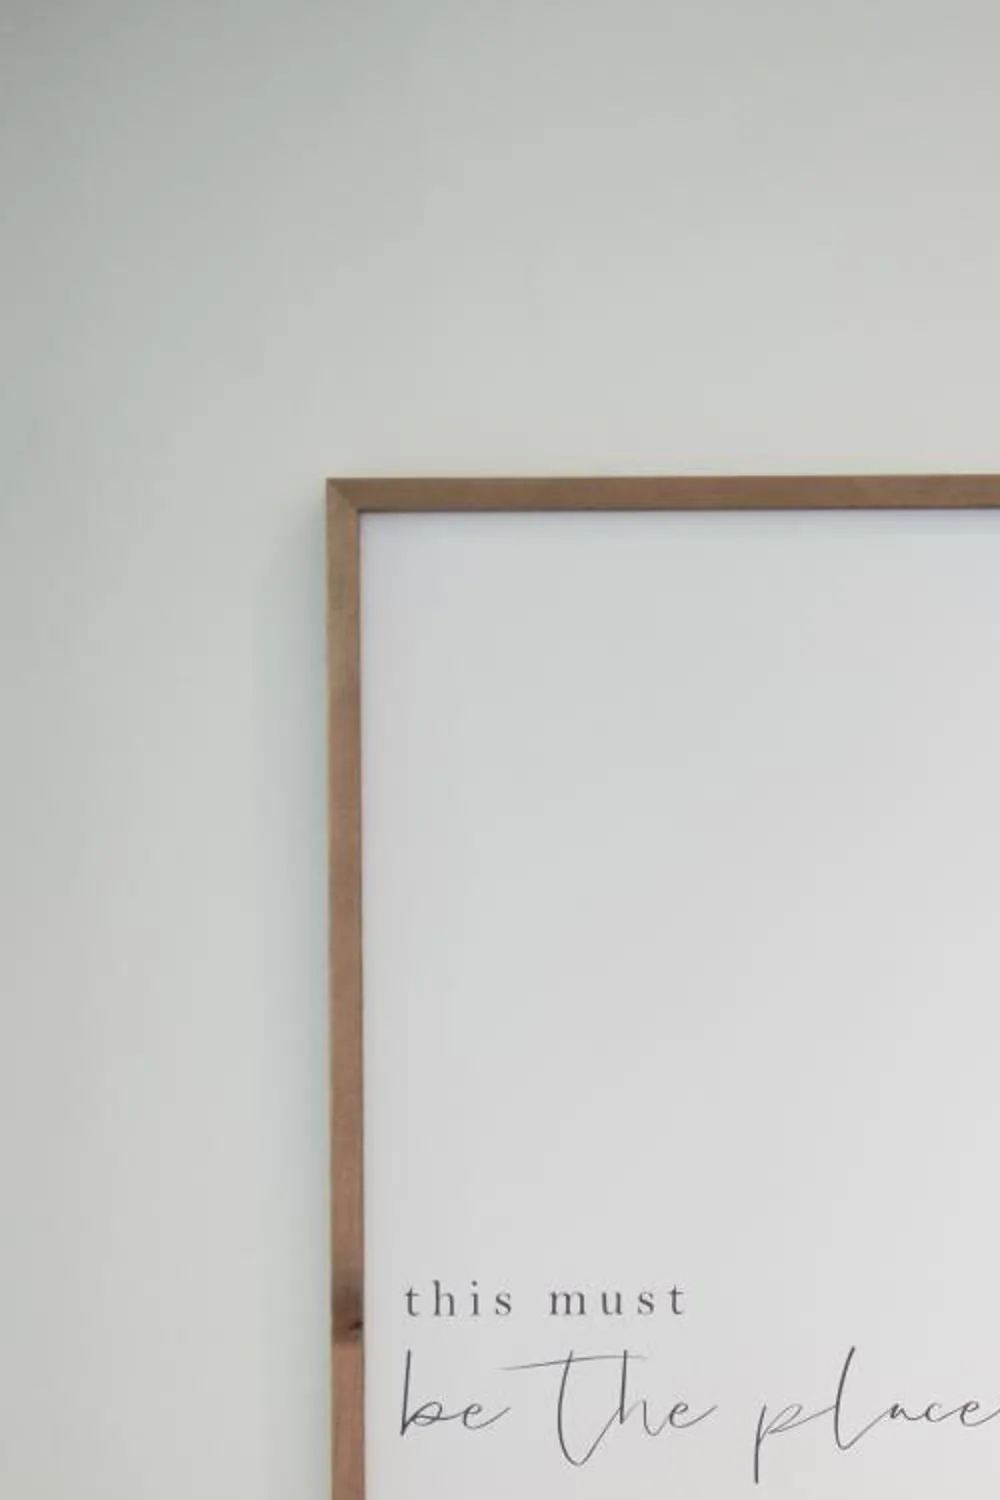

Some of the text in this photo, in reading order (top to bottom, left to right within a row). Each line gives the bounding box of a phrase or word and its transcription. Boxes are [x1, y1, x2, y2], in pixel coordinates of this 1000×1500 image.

[404, 1279, 686, 1317] this must
[399, 1349, 511, 1437] be
